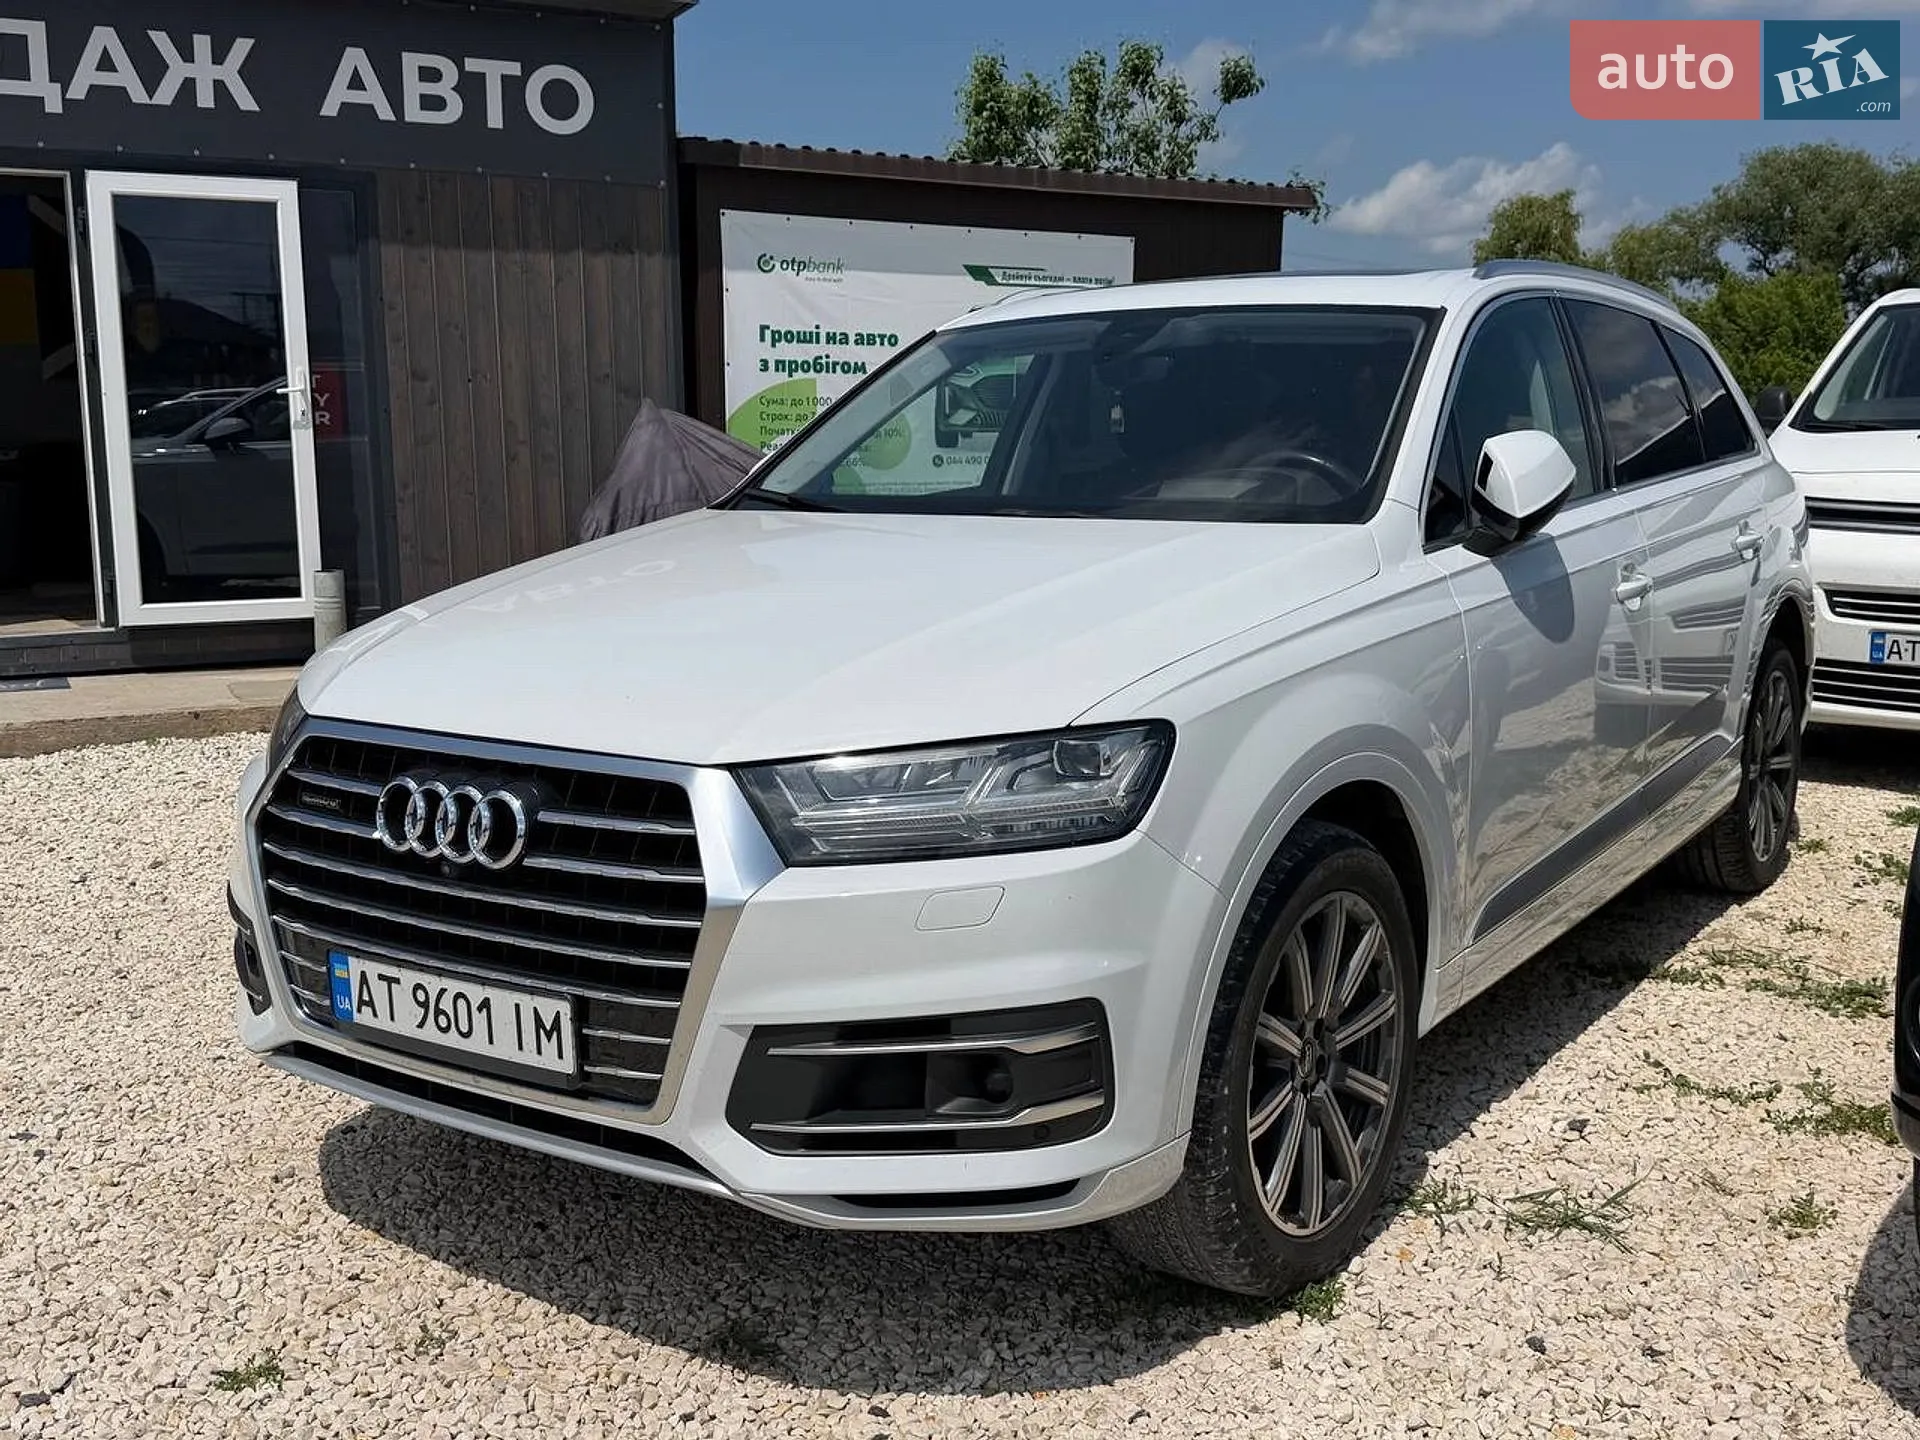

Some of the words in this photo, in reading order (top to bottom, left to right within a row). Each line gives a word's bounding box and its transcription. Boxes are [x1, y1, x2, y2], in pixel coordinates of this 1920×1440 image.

[319, 47, 595, 135] АВТО
[759, 324, 821, 348] Гроші
[825, 331, 850, 346] на
[854, 332, 899, 347] авто
[759, 358, 769, 372] з
[774, 354, 868, 378] пробігом
[759, 396, 788, 407] Сума:
[791, 397, 804, 407] до
[759, 411, 793, 423] Строк:
[336, 995, 352, 1010] UA
[356, 970, 401, 1022] AT
[411, 982, 494, 1046] 9601
[514, 1002, 564, 1061] IM
